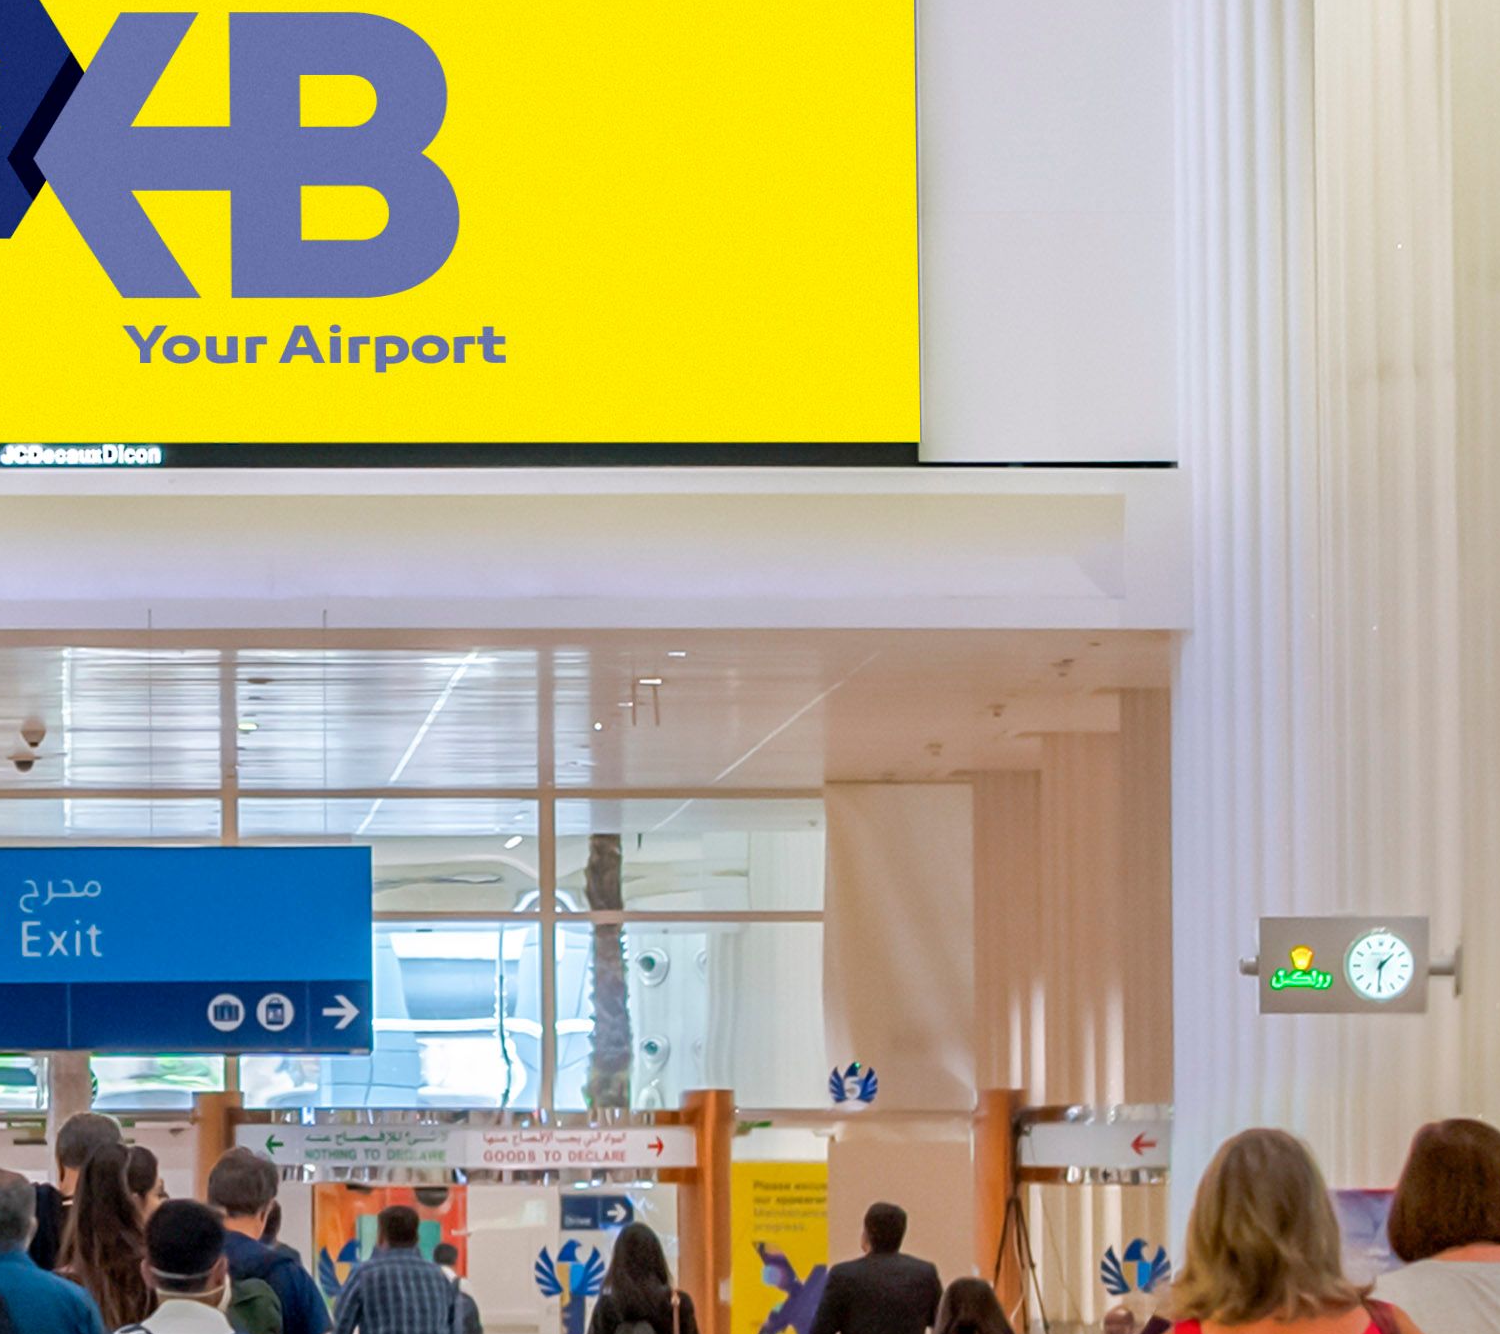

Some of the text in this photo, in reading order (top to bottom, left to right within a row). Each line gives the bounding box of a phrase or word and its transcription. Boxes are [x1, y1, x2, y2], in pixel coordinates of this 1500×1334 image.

[122, 324, 508, 373] Your Airport
[21, 918, 103, 958] Exit
[304, 1148, 357, 1162] NOTHING
[364, 1148, 381, 1162] TO
[482, 1150, 627, 1163] GOODS TO DECLARE
